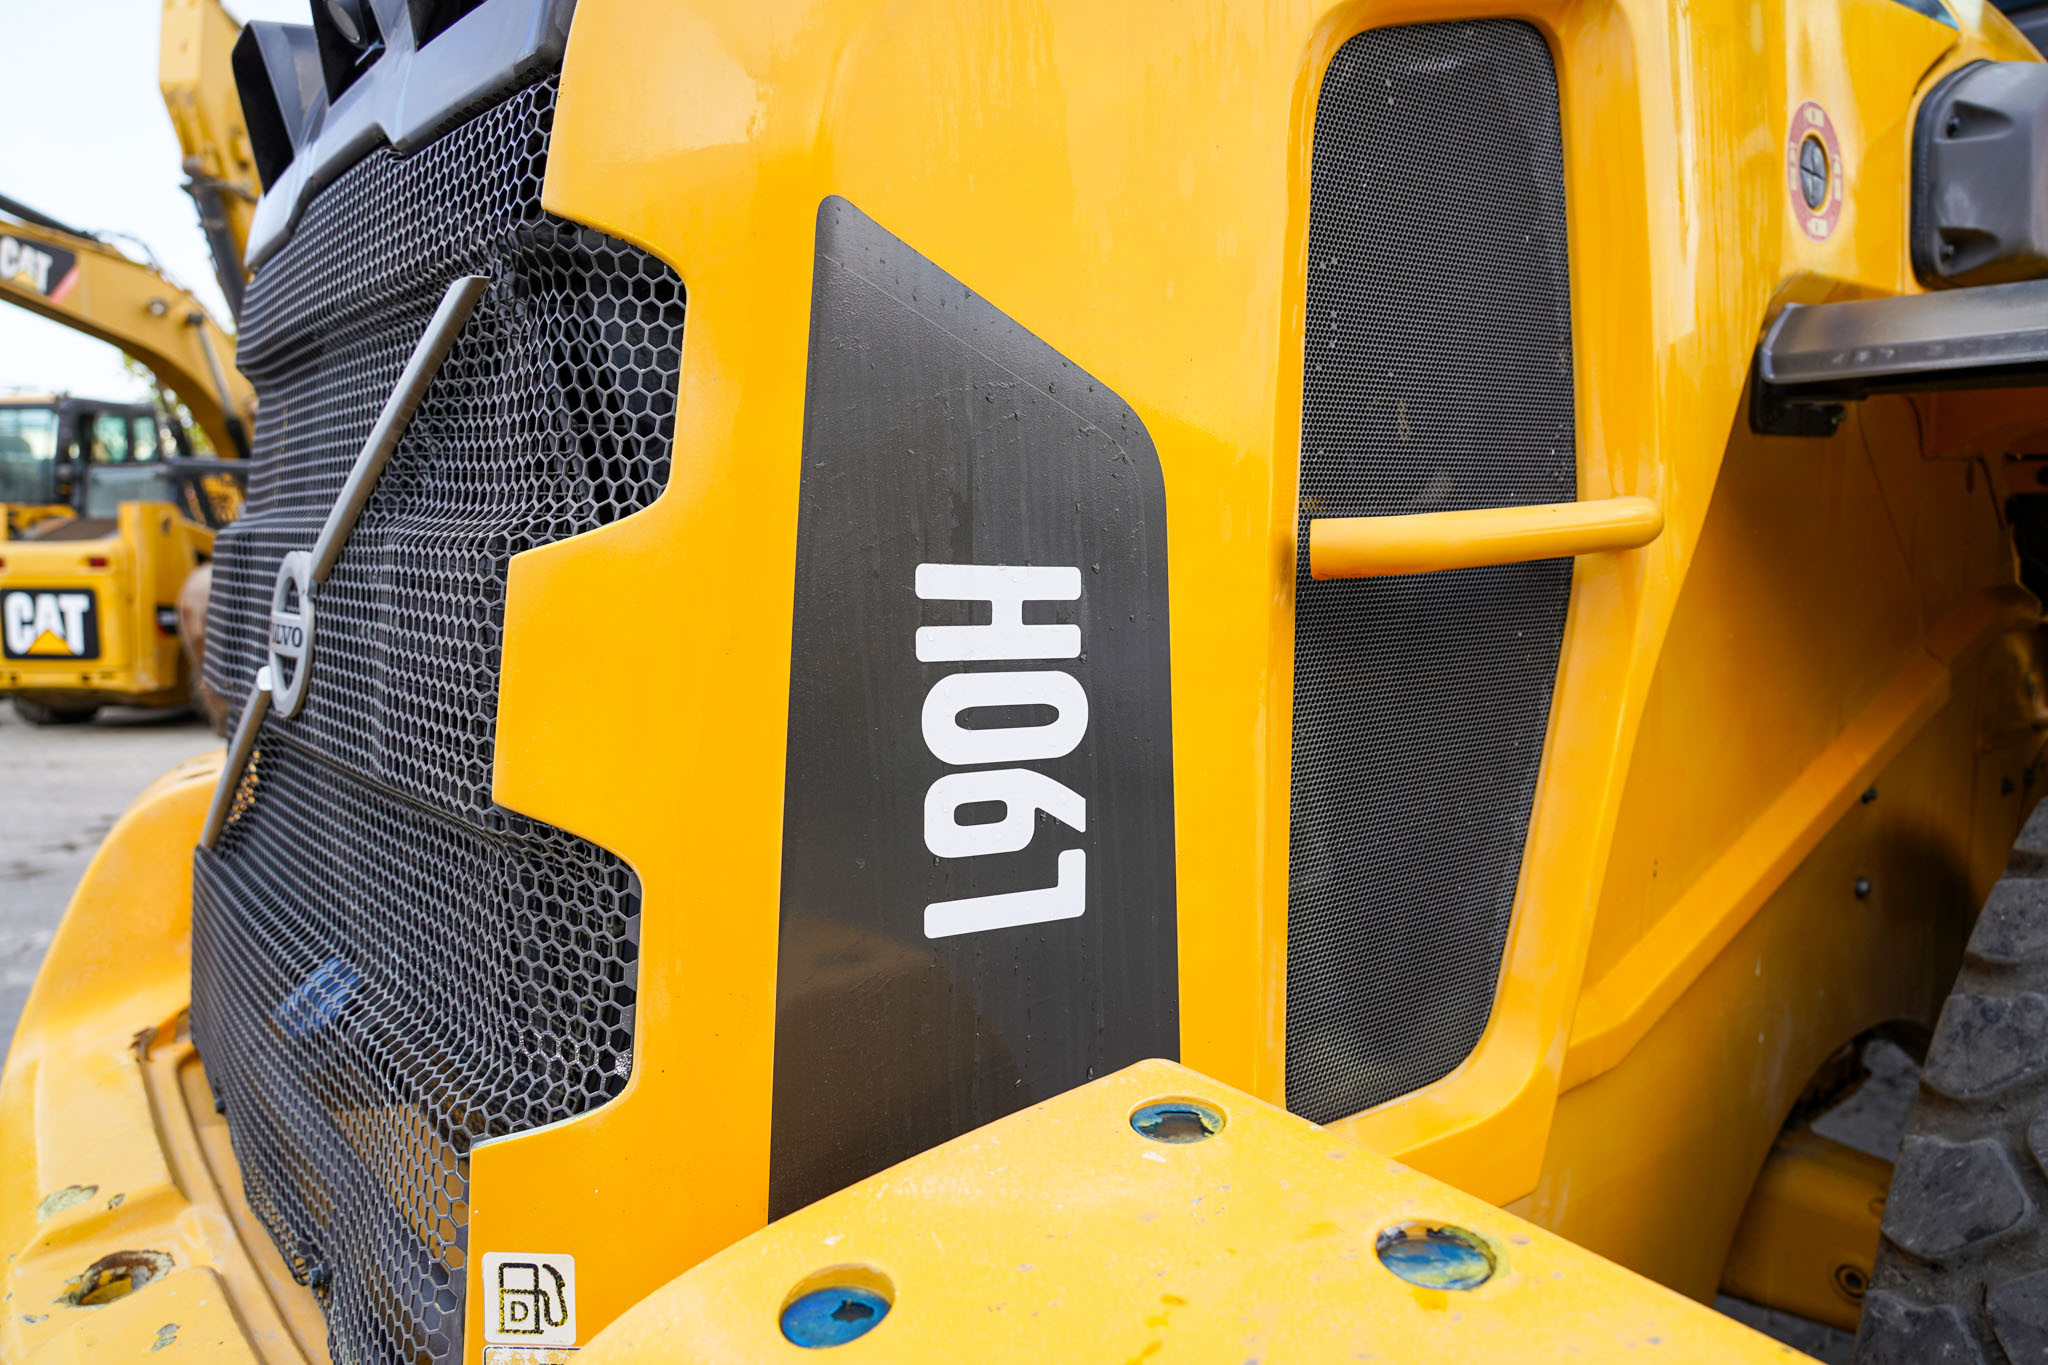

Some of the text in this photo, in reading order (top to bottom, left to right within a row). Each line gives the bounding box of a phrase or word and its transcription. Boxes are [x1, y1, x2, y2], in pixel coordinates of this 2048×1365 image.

[0, 235, 54, 294] CAT
[4, 591, 90, 655] CAT
[915, 563, 1089, 939] L90H
[511, 1300, 529, 1322] D
